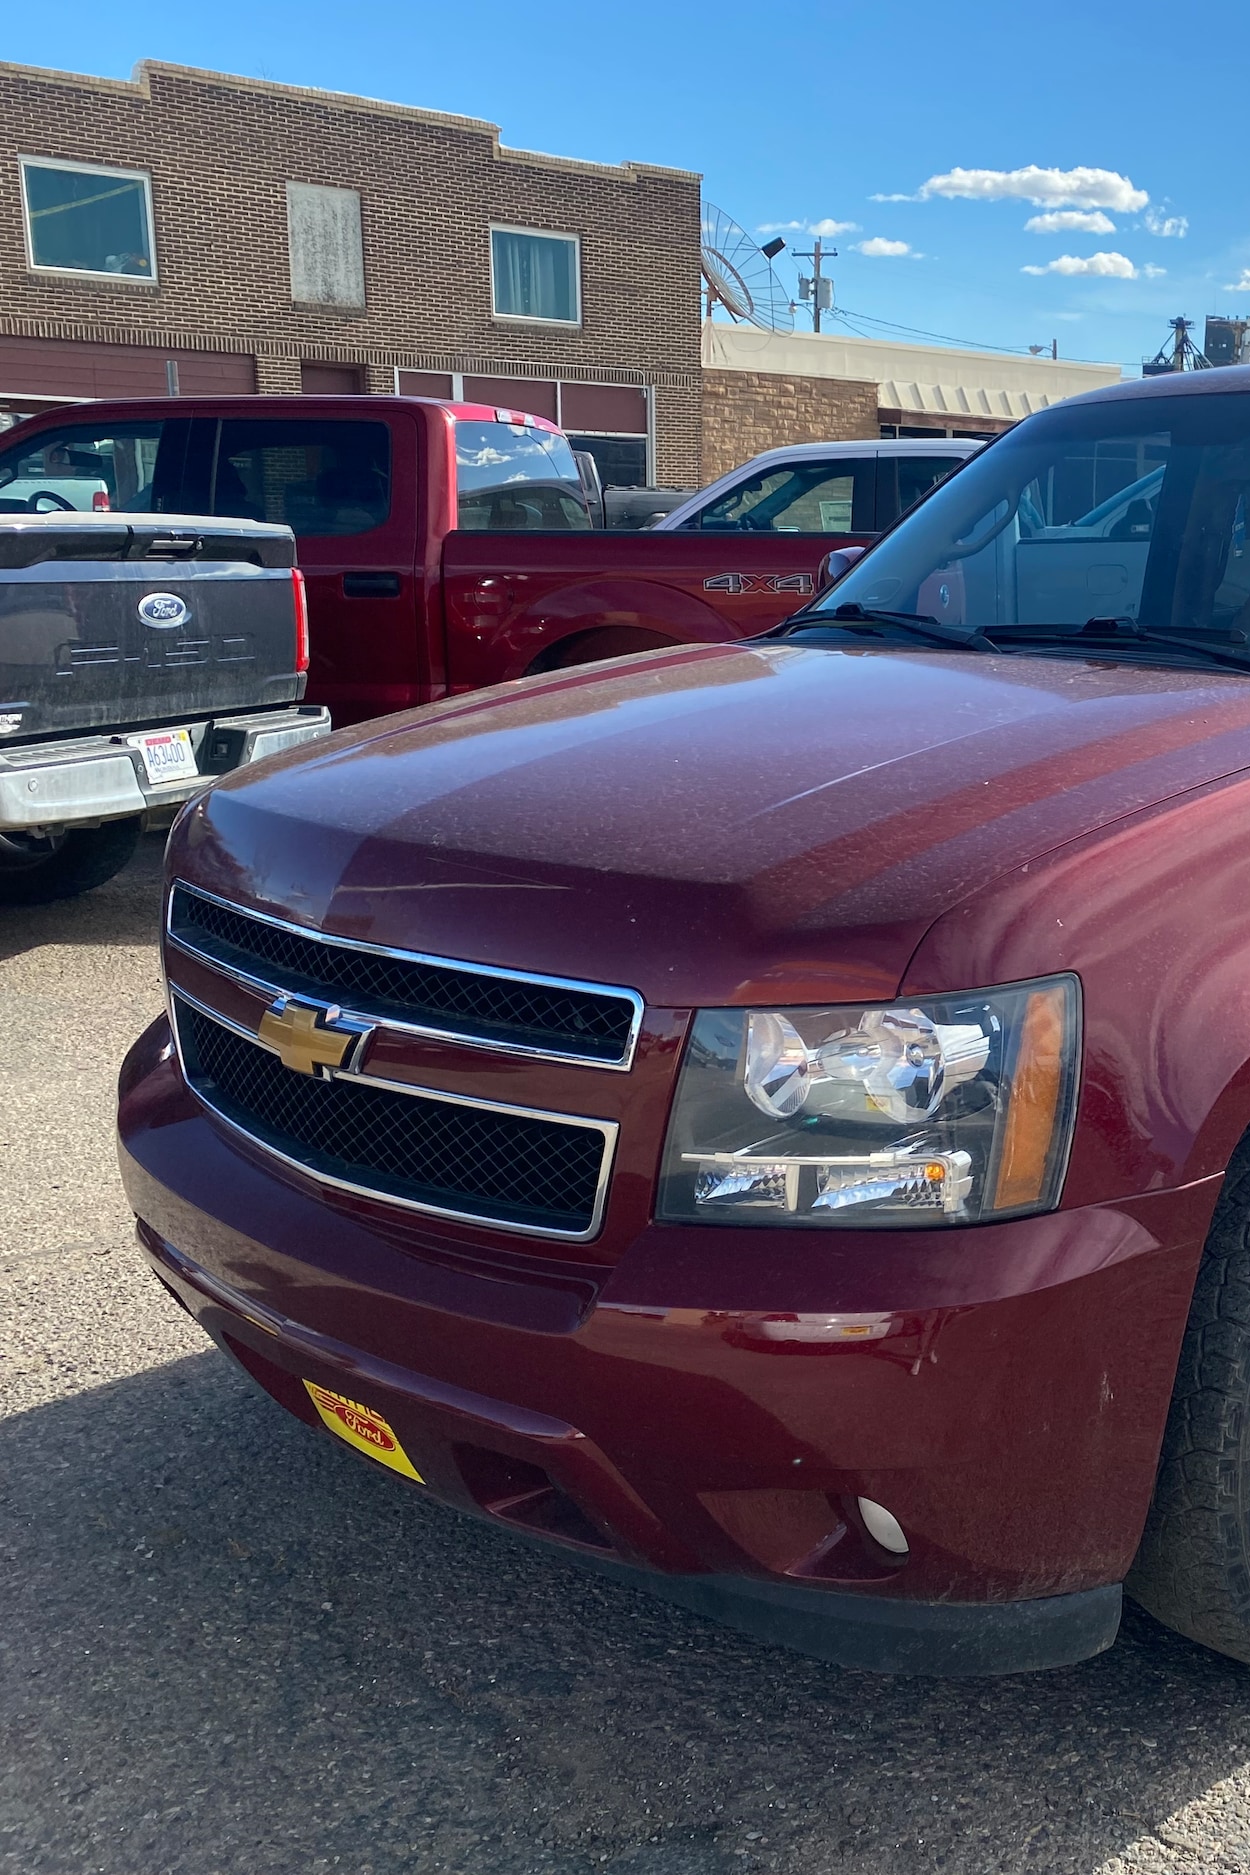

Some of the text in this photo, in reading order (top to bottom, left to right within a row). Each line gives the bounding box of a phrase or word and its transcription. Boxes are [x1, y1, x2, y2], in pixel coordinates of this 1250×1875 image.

[151, 599, 178, 618] Ford
[146, 742, 185, 768] A63400
[344, 1408, 385, 1447] Ford
